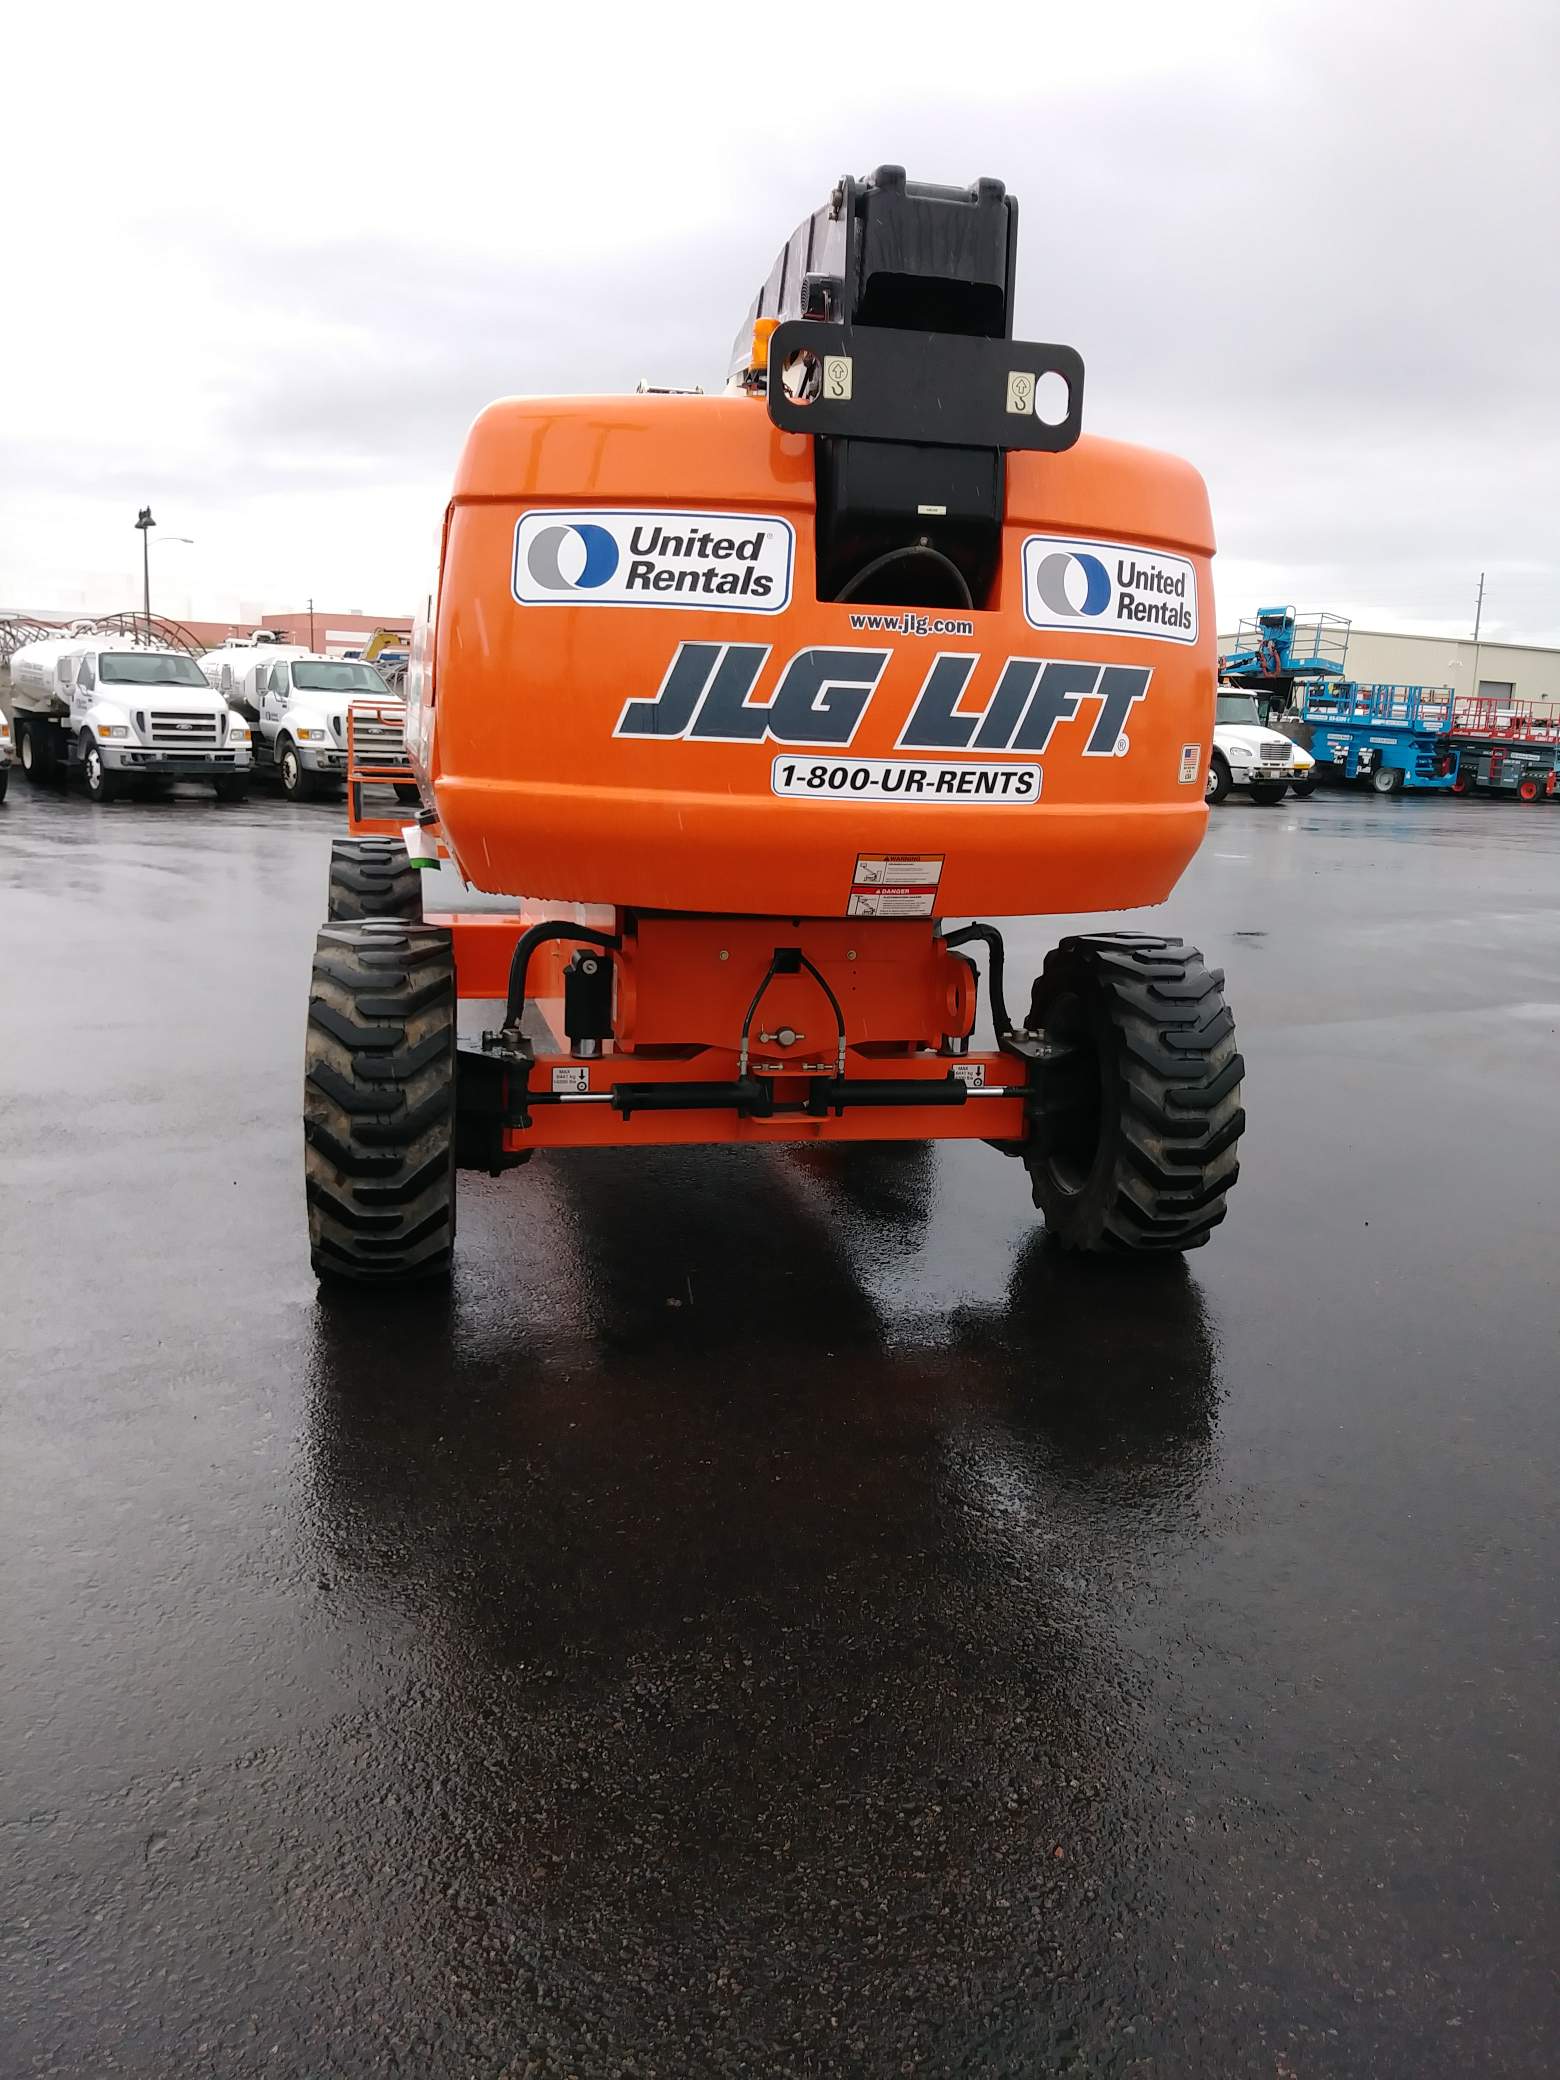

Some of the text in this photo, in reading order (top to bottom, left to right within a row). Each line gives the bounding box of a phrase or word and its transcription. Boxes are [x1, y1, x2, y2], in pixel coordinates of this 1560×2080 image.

[629, 526, 766, 561] United
[625, 560, 774, 597] Rentals
[1116, 559, 1186, 598] United
[849, 612, 974, 636] www.jlg.com
[1116, 591, 1192, 630] Rentals
[611, 640, 1154, 757] JLG LIFT
[781, 764, 1035, 795] 1-800-UR-RENTS
